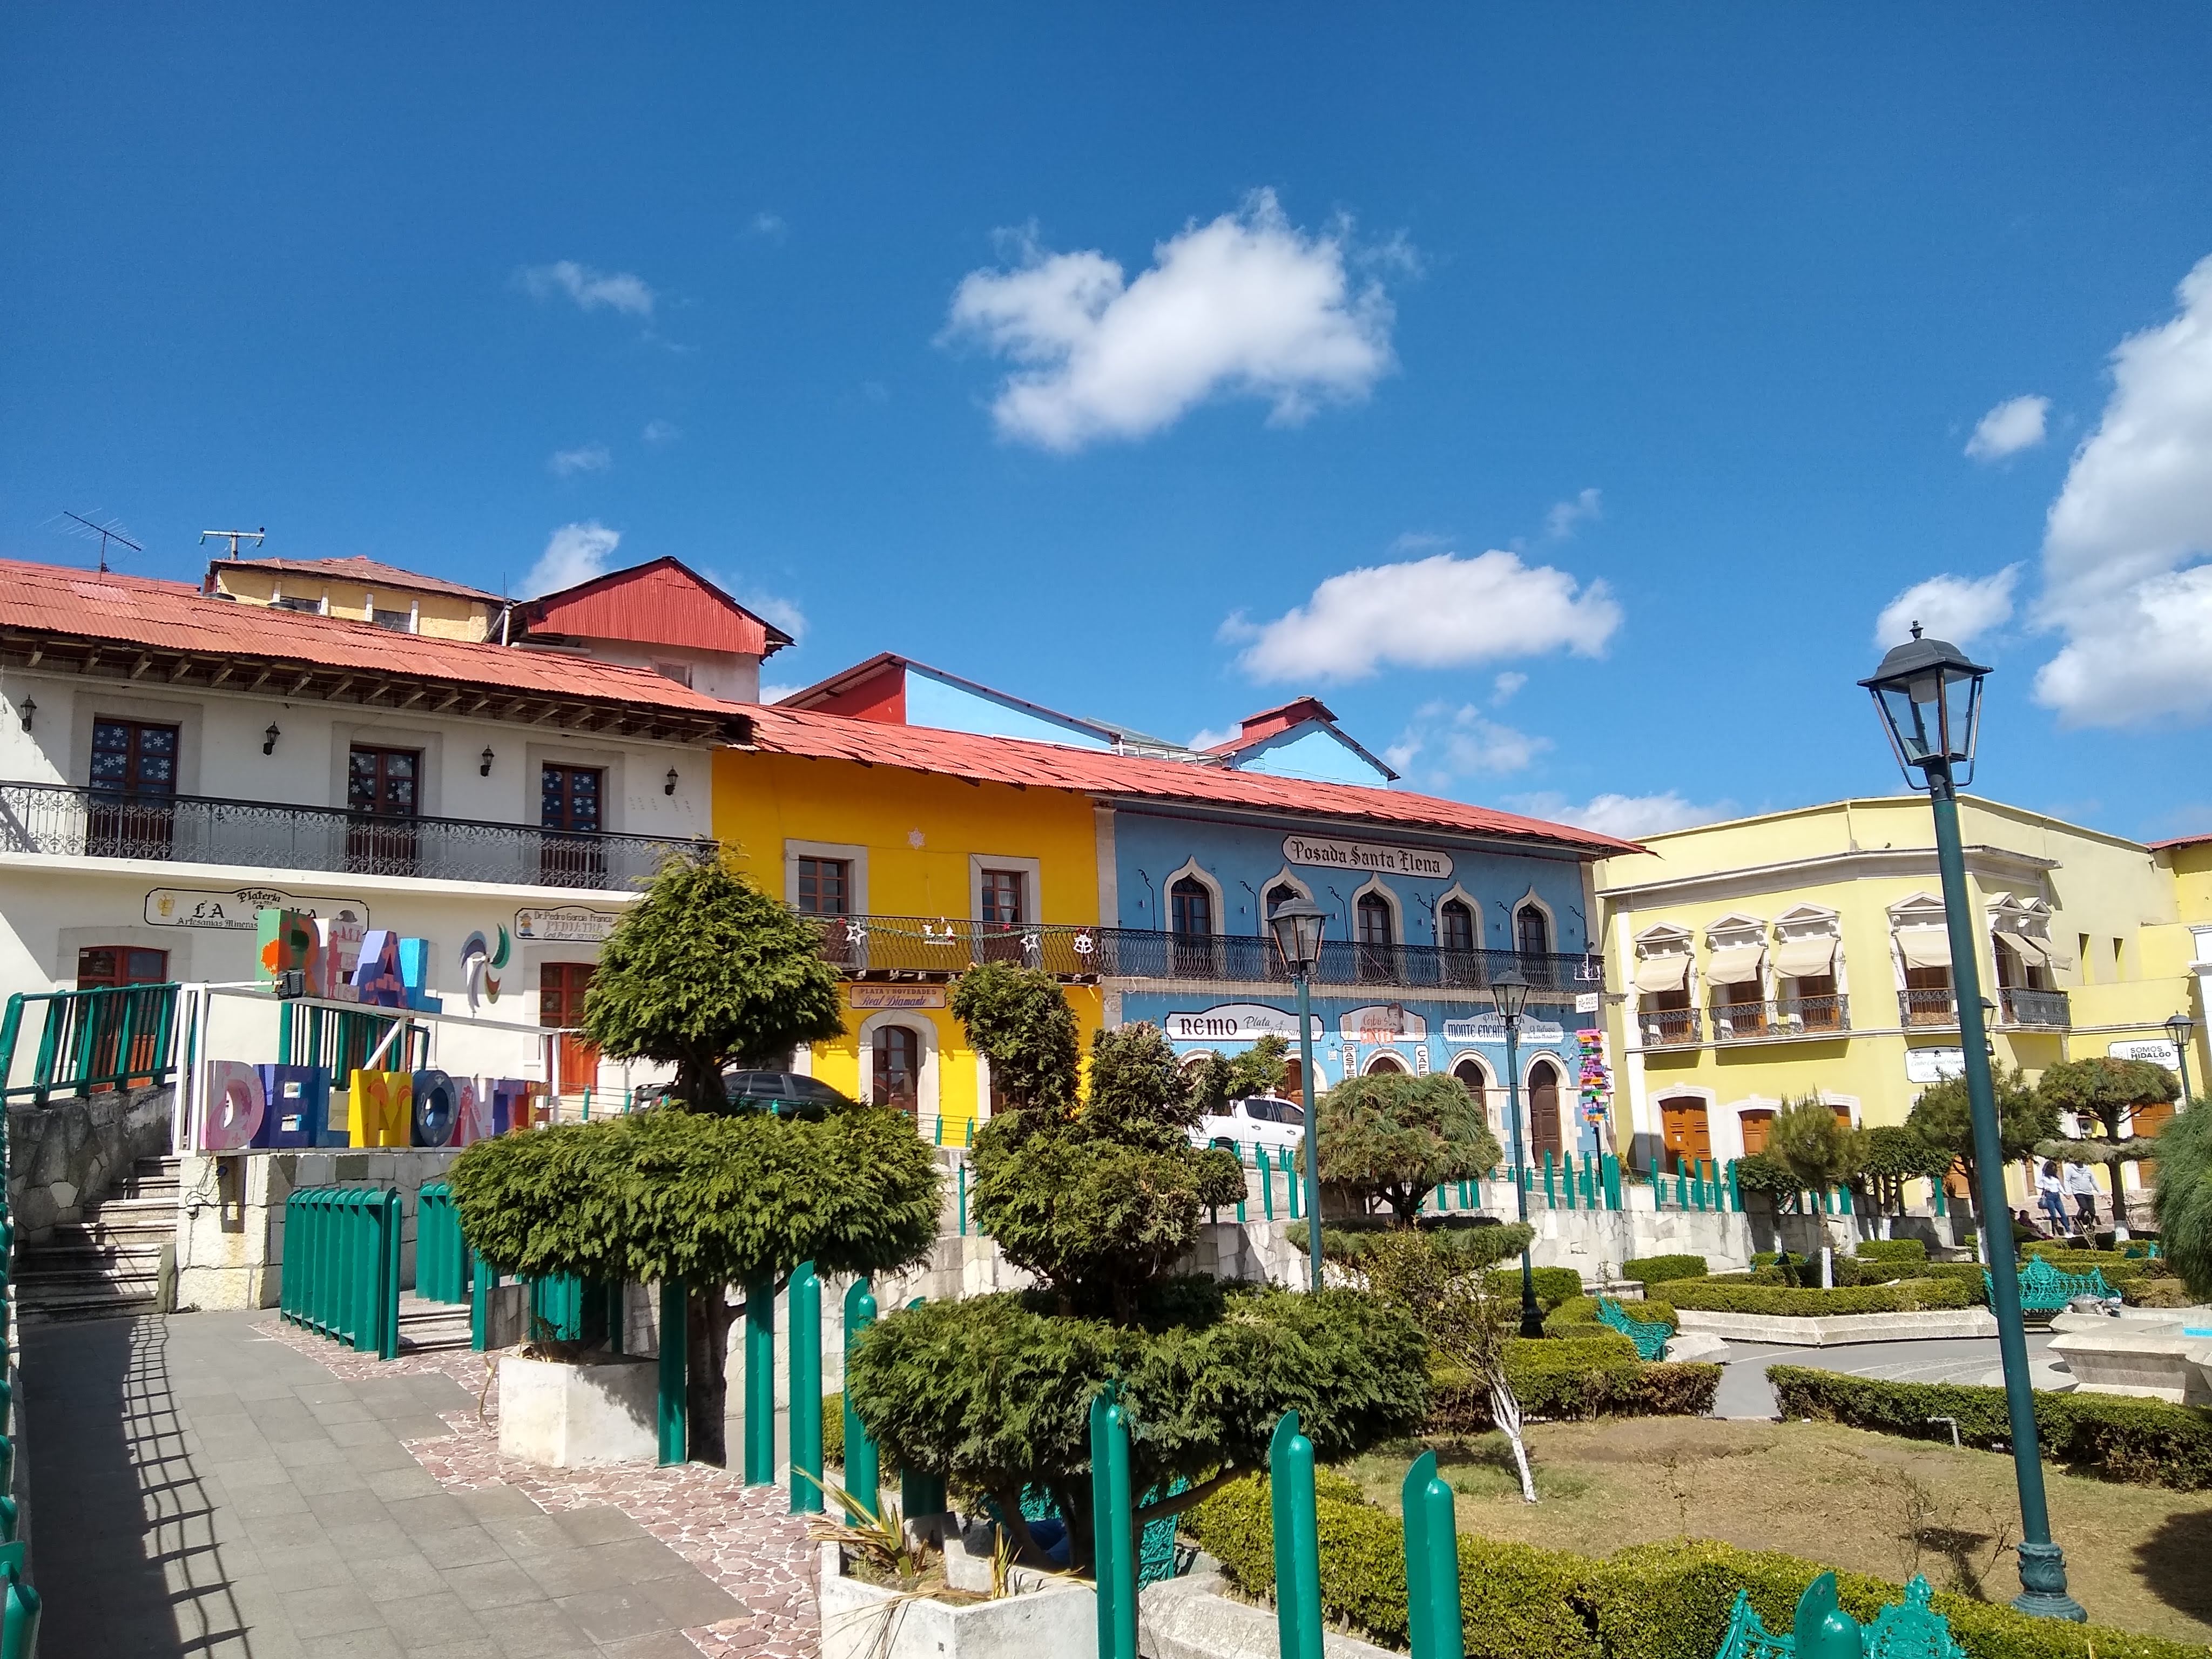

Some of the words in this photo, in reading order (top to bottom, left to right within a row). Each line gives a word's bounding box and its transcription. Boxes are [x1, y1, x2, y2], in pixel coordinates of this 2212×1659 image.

[1290, 838, 1347, 863] Posada
[1350, 845, 1395, 868] Santa
[1397, 849, 1441, 873] Elena
[192, 900, 225, 919] LA
[590, 914, 612, 922] Franco
[224, 920, 258, 928] Mineras
[545, 921, 604, 933] PEDIATRA
[255, 909, 443, 1014] REAL
[861, 995, 885, 1006] Real
[885, 995, 927, 1006] Diamante
[1179, 1018, 1237, 1035] REMO
[1244, 1016, 1270, 1028] Plata
[1448, 1023, 1476, 1037] MONTE
[1344, 1046, 1355, 1078] PASTE
[200, 1060, 352, 1150] DEL
